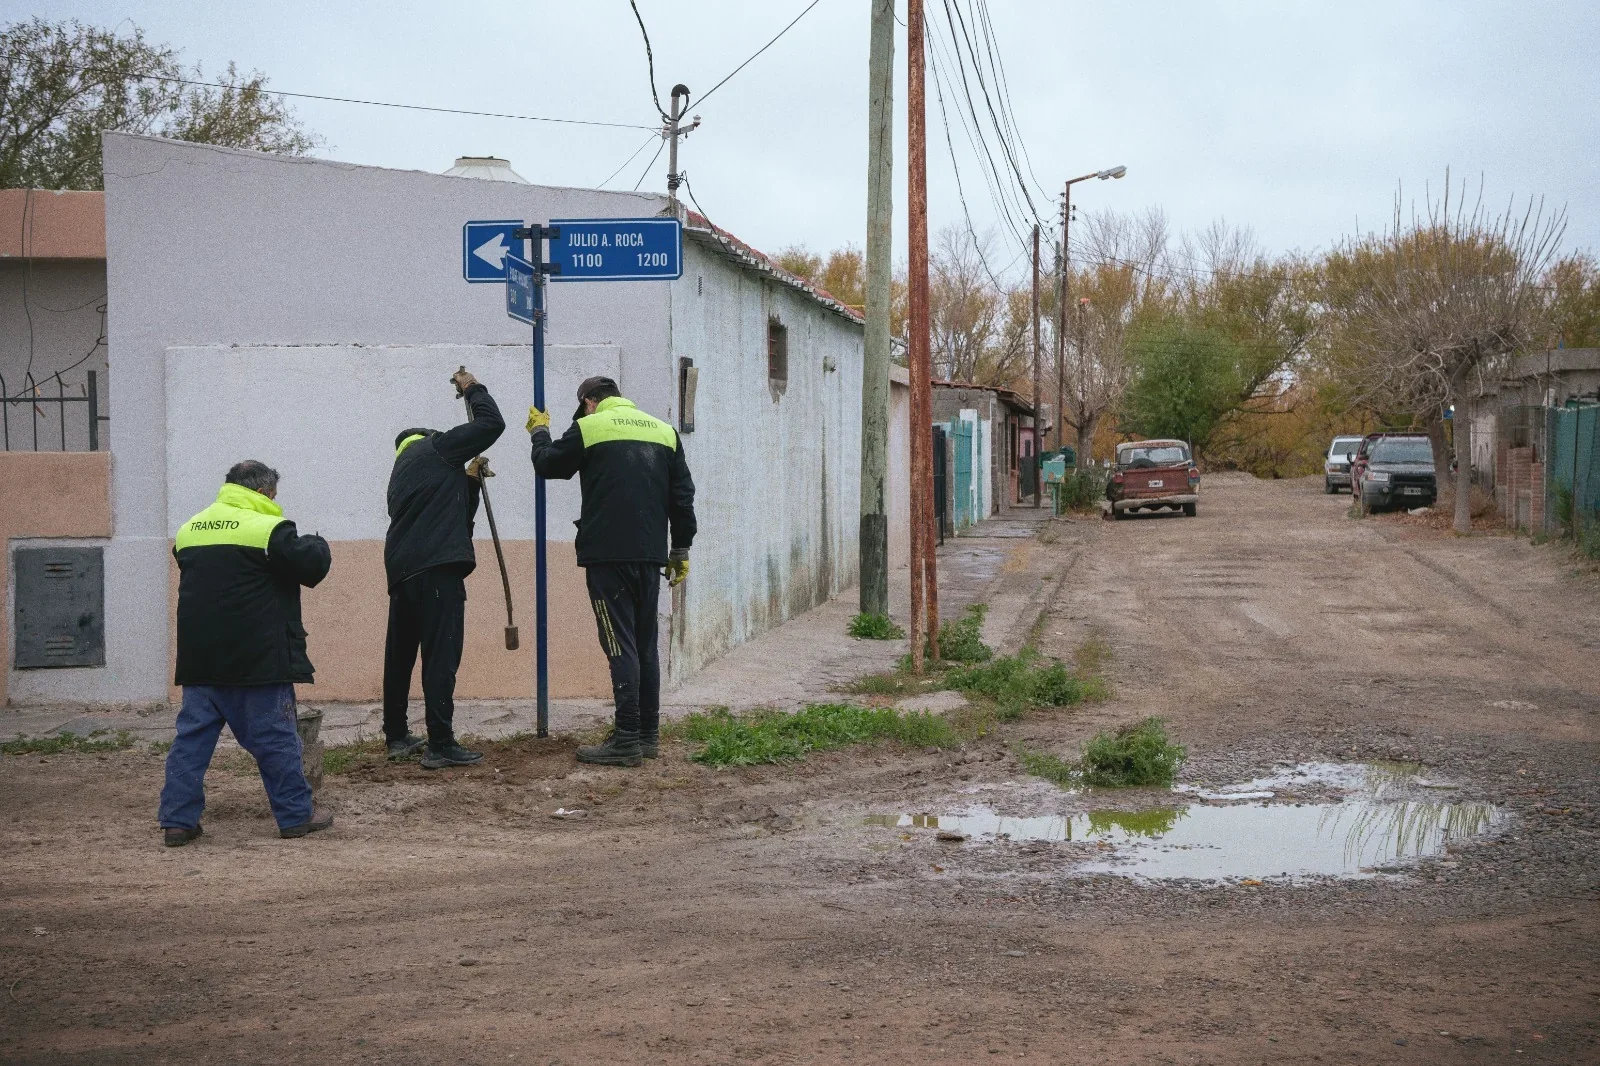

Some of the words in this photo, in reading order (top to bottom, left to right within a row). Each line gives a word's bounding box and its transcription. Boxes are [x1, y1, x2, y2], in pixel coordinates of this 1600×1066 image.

[568, 233, 598, 247] JULIO
[601, 233, 612, 247] A.
[615, 233, 644, 247] ROCA
[572, 253, 603, 268] 1100
[636, 252, 668, 267] 1200
[610, 418, 658, 429] TRANSITO
[190, 520, 240, 532] TRANSITO
